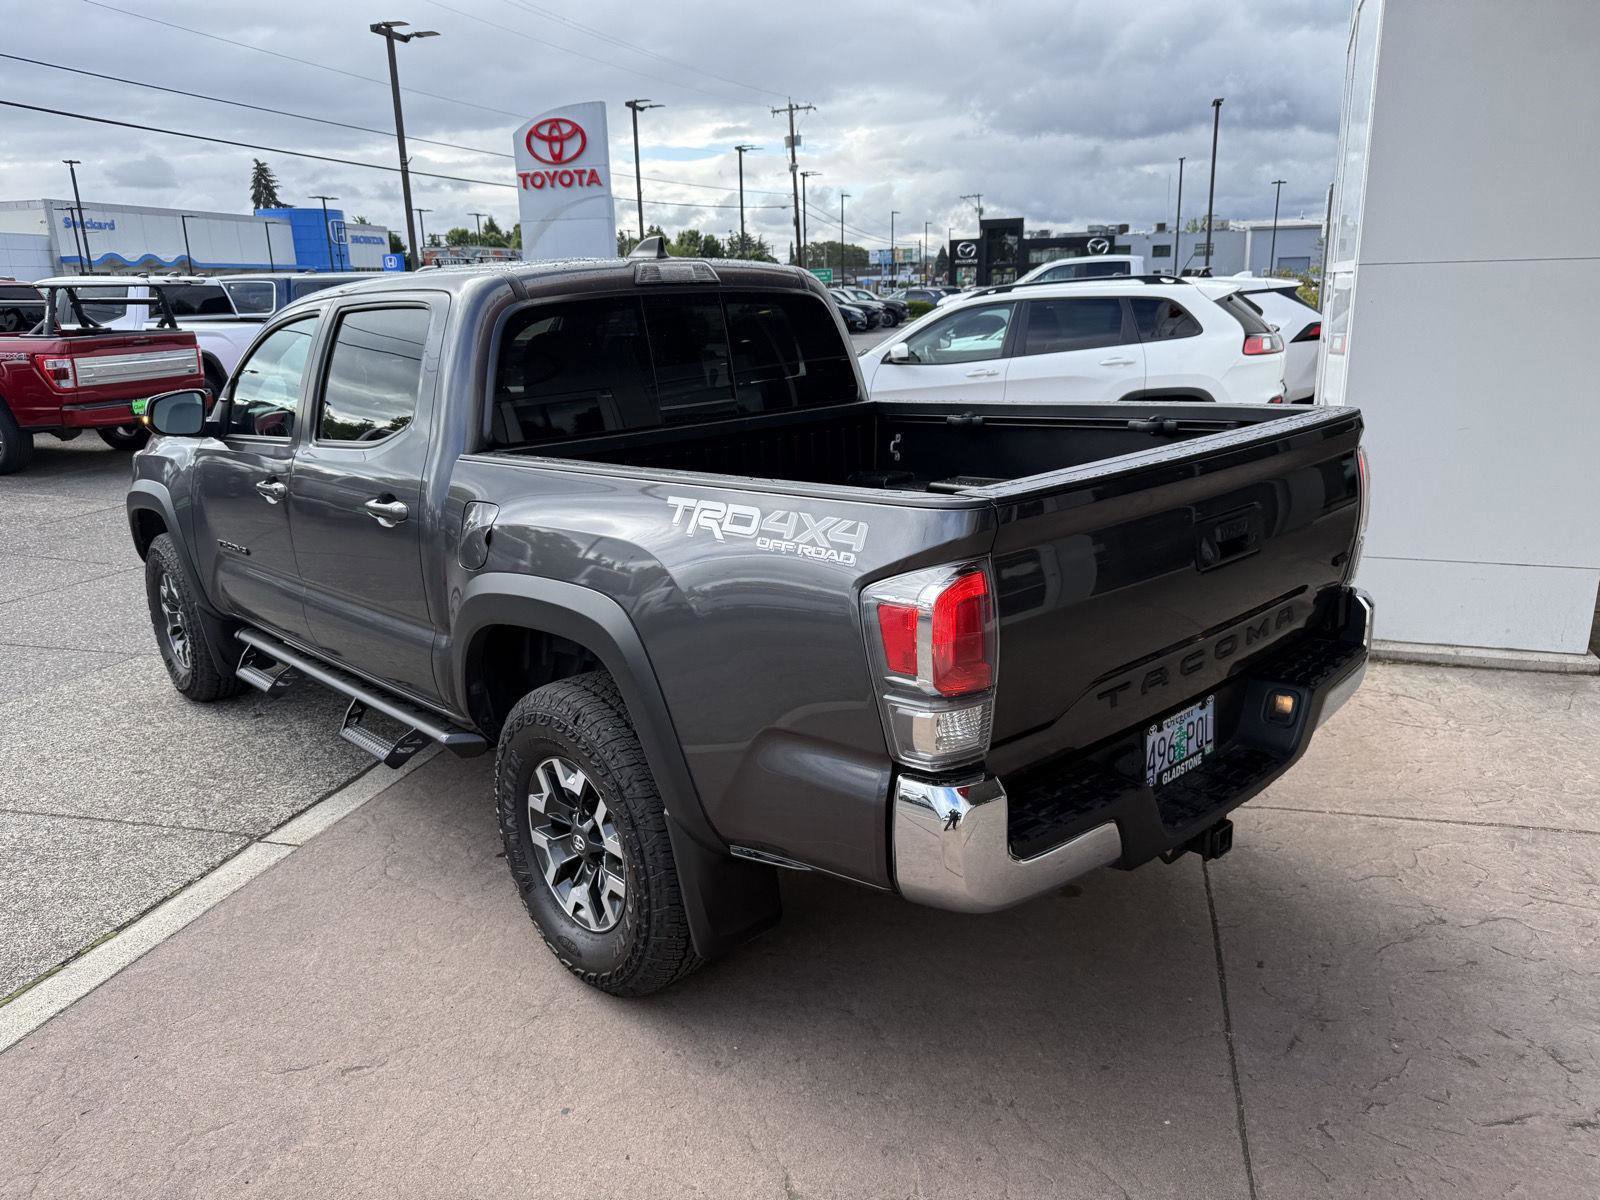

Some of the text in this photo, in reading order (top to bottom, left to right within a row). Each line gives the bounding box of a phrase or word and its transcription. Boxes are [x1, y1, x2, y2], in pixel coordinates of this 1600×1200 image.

[518, 168, 603, 190] TOYOTA
[351, 235, 386, 245] HONDA
[667, 496, 869, 553] TRD 4X4
[755, 536, 857, 567] OFF ROAD
[1097, 605, 1294, 708] TACOMA
[1147, 714, 1213, 775] 496 PQL
[1162, 753, 1203, 785] GLADSTONE
